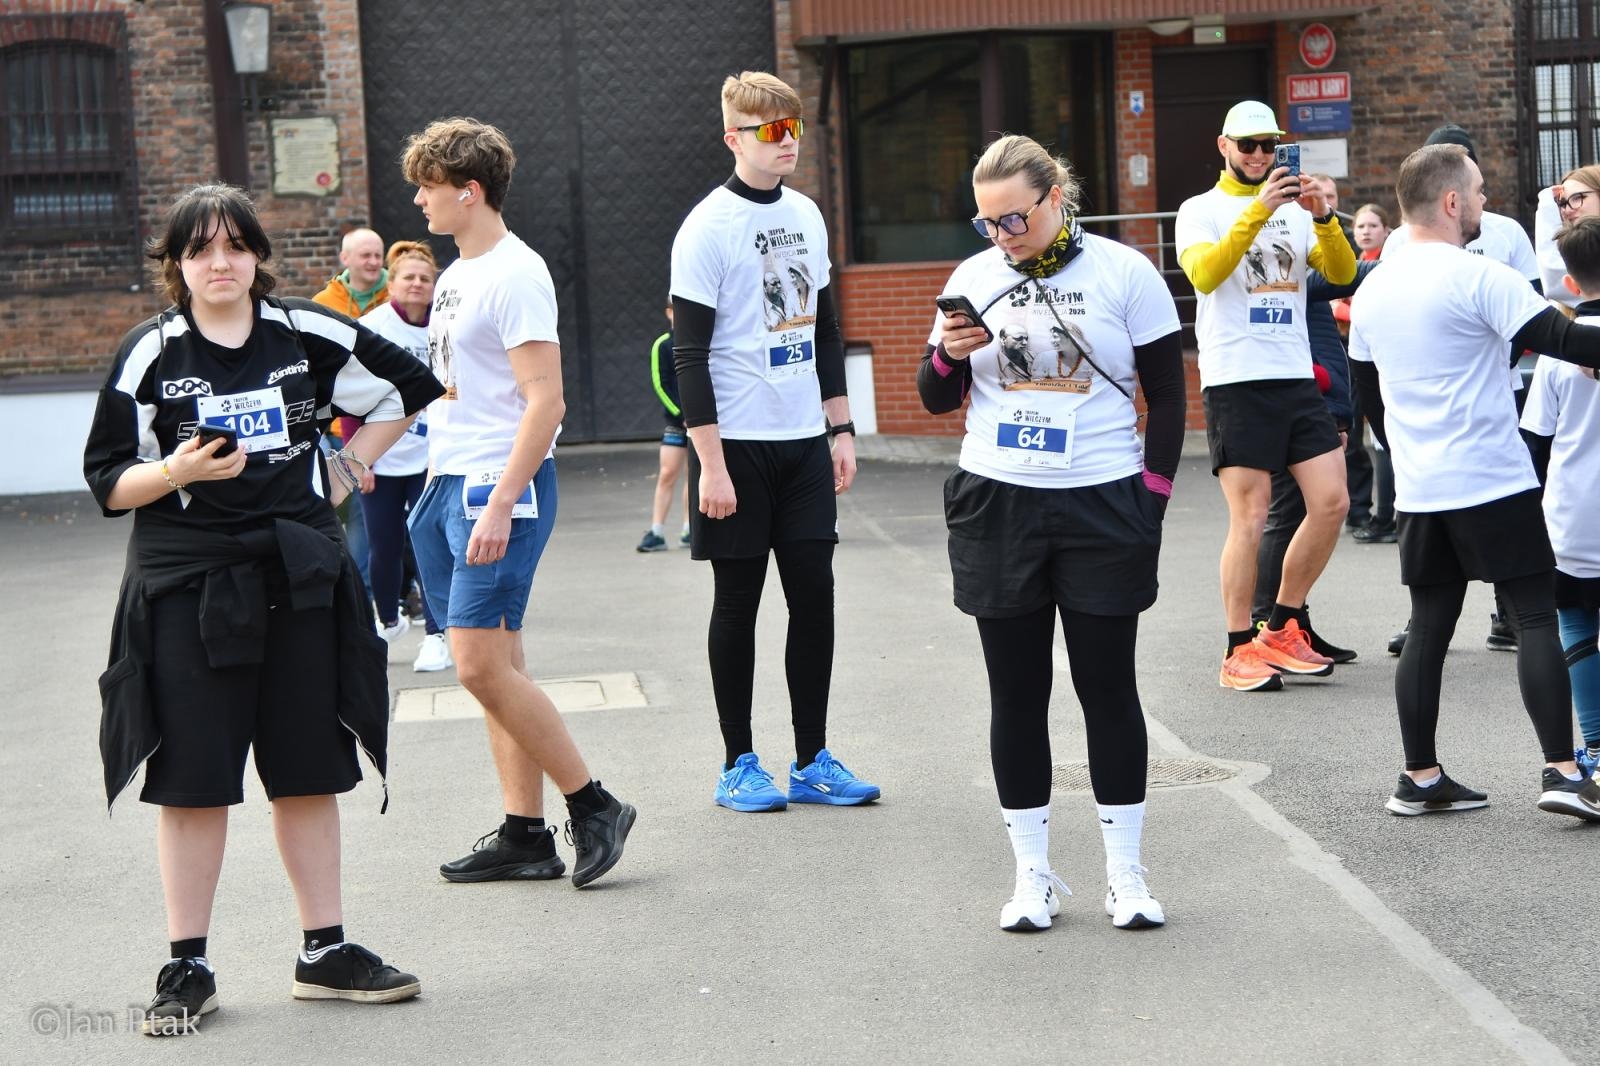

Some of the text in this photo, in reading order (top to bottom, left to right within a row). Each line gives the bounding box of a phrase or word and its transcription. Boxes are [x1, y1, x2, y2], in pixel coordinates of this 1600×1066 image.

[770, 232, 805, 247] WILCZYM
[1069, 307, 1086, 315] 2026
[1266, 309, 1284, 322] 17
[786, 343, 804, 363] 25
[235, 399, 262, 410] WILCZYM
[224, 411, 271, 436] 104
[1025, 415, 1051, 424] WILCZYM
[1017, 427, 1046, 449] 64
